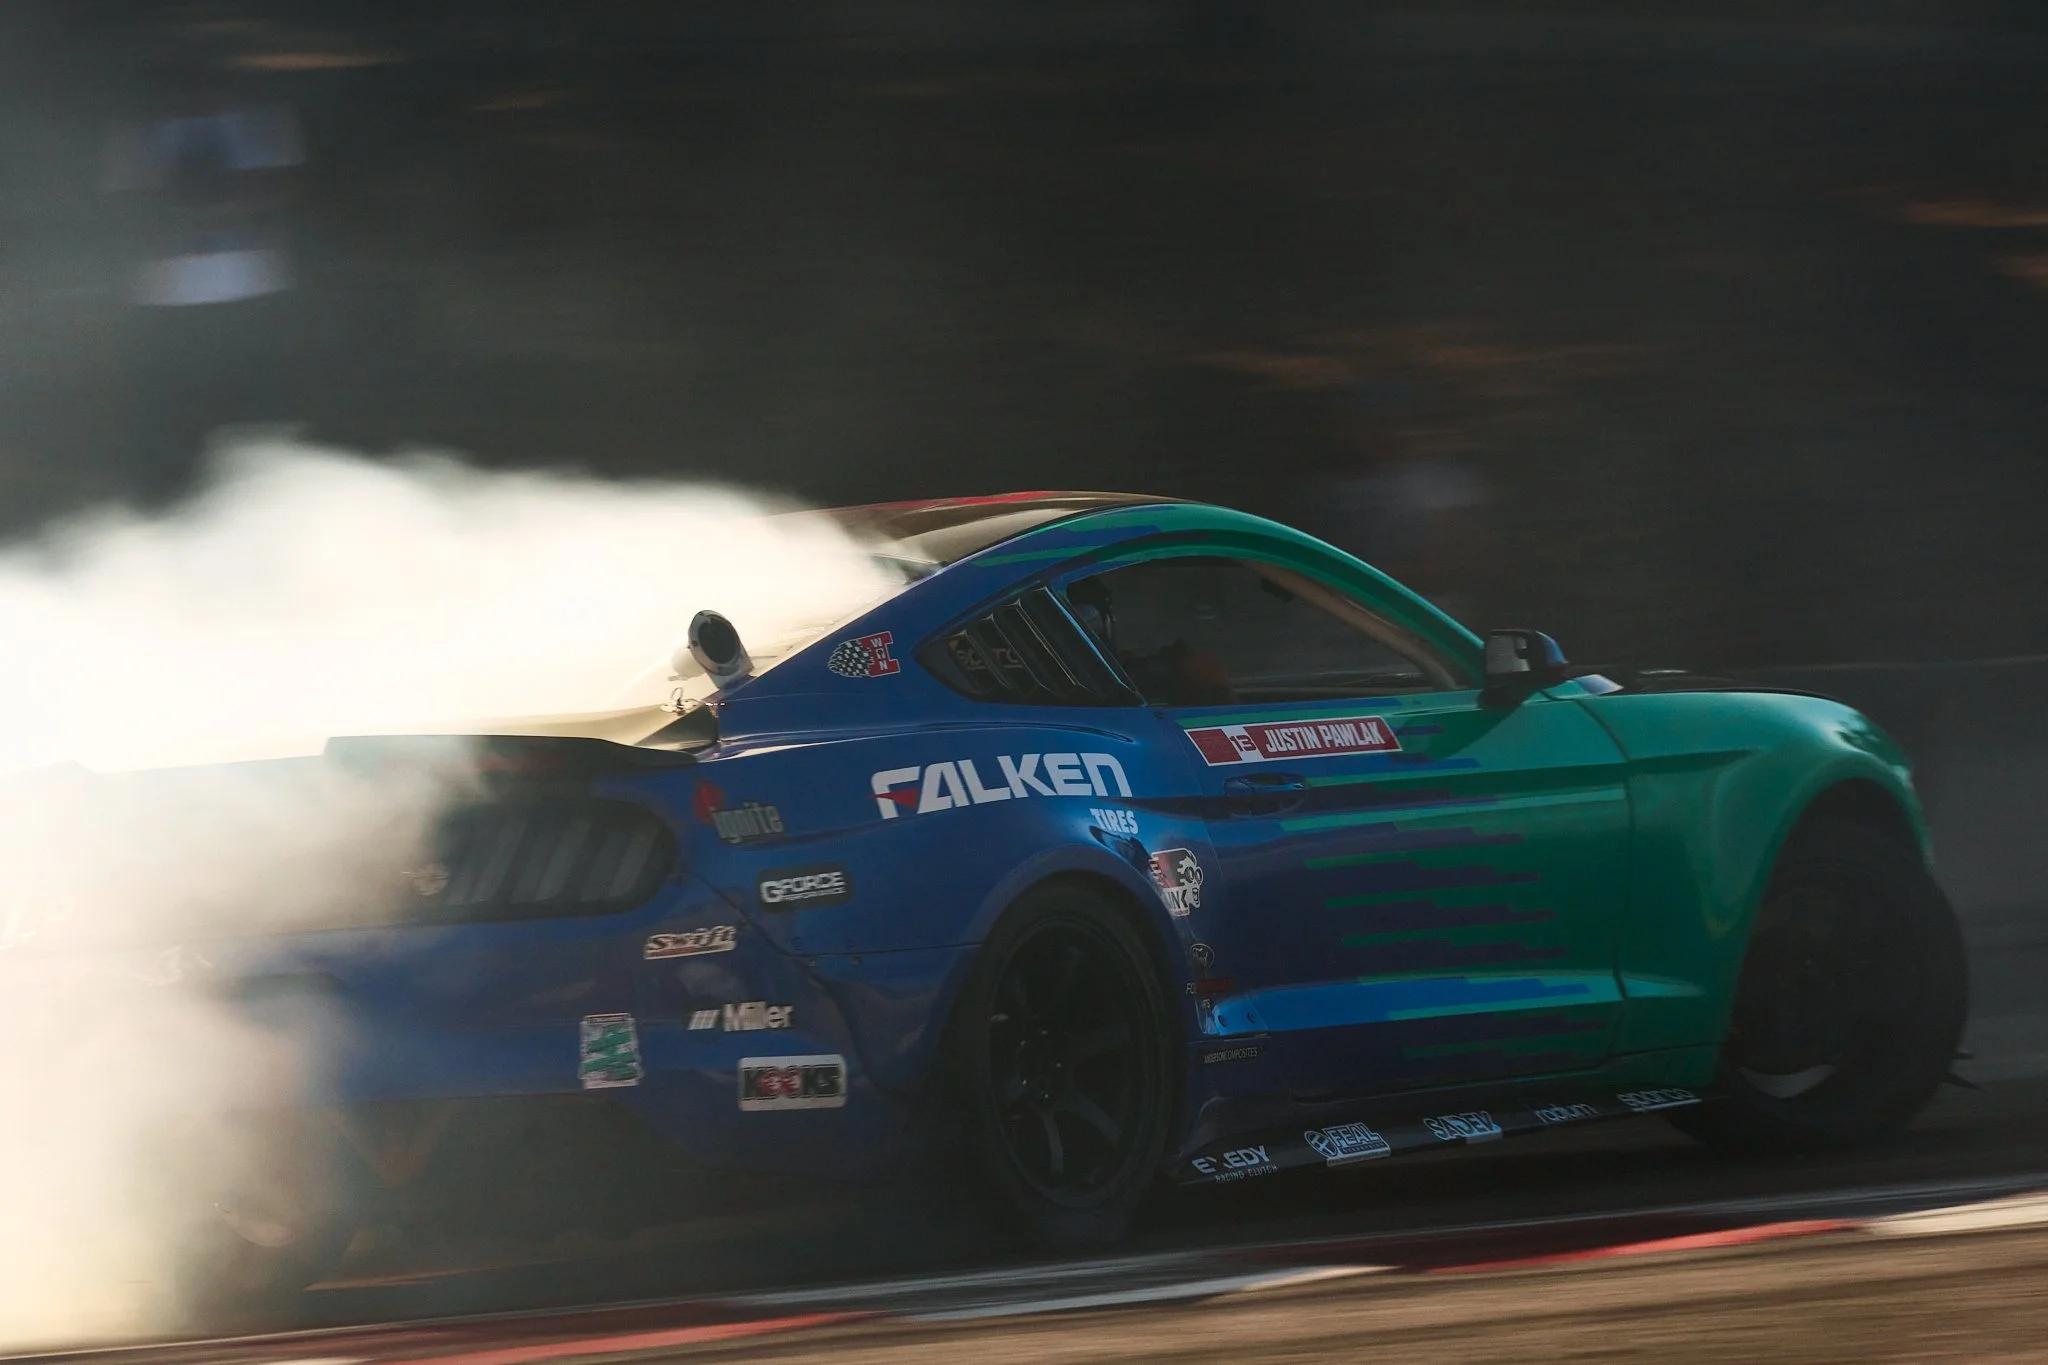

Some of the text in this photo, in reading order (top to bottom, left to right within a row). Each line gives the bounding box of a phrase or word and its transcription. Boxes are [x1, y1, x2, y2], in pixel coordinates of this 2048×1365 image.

[1230, 721, 1386, 753] 13 JUSTIN PAWLAK
[870, 752, 1133, 820] FALKEN
[1089, 808, 1138, 835] TIRES
[1327, 1123, 1381, 1148] FEAL
[1423, 1110, 1498, 1141] SADEV
